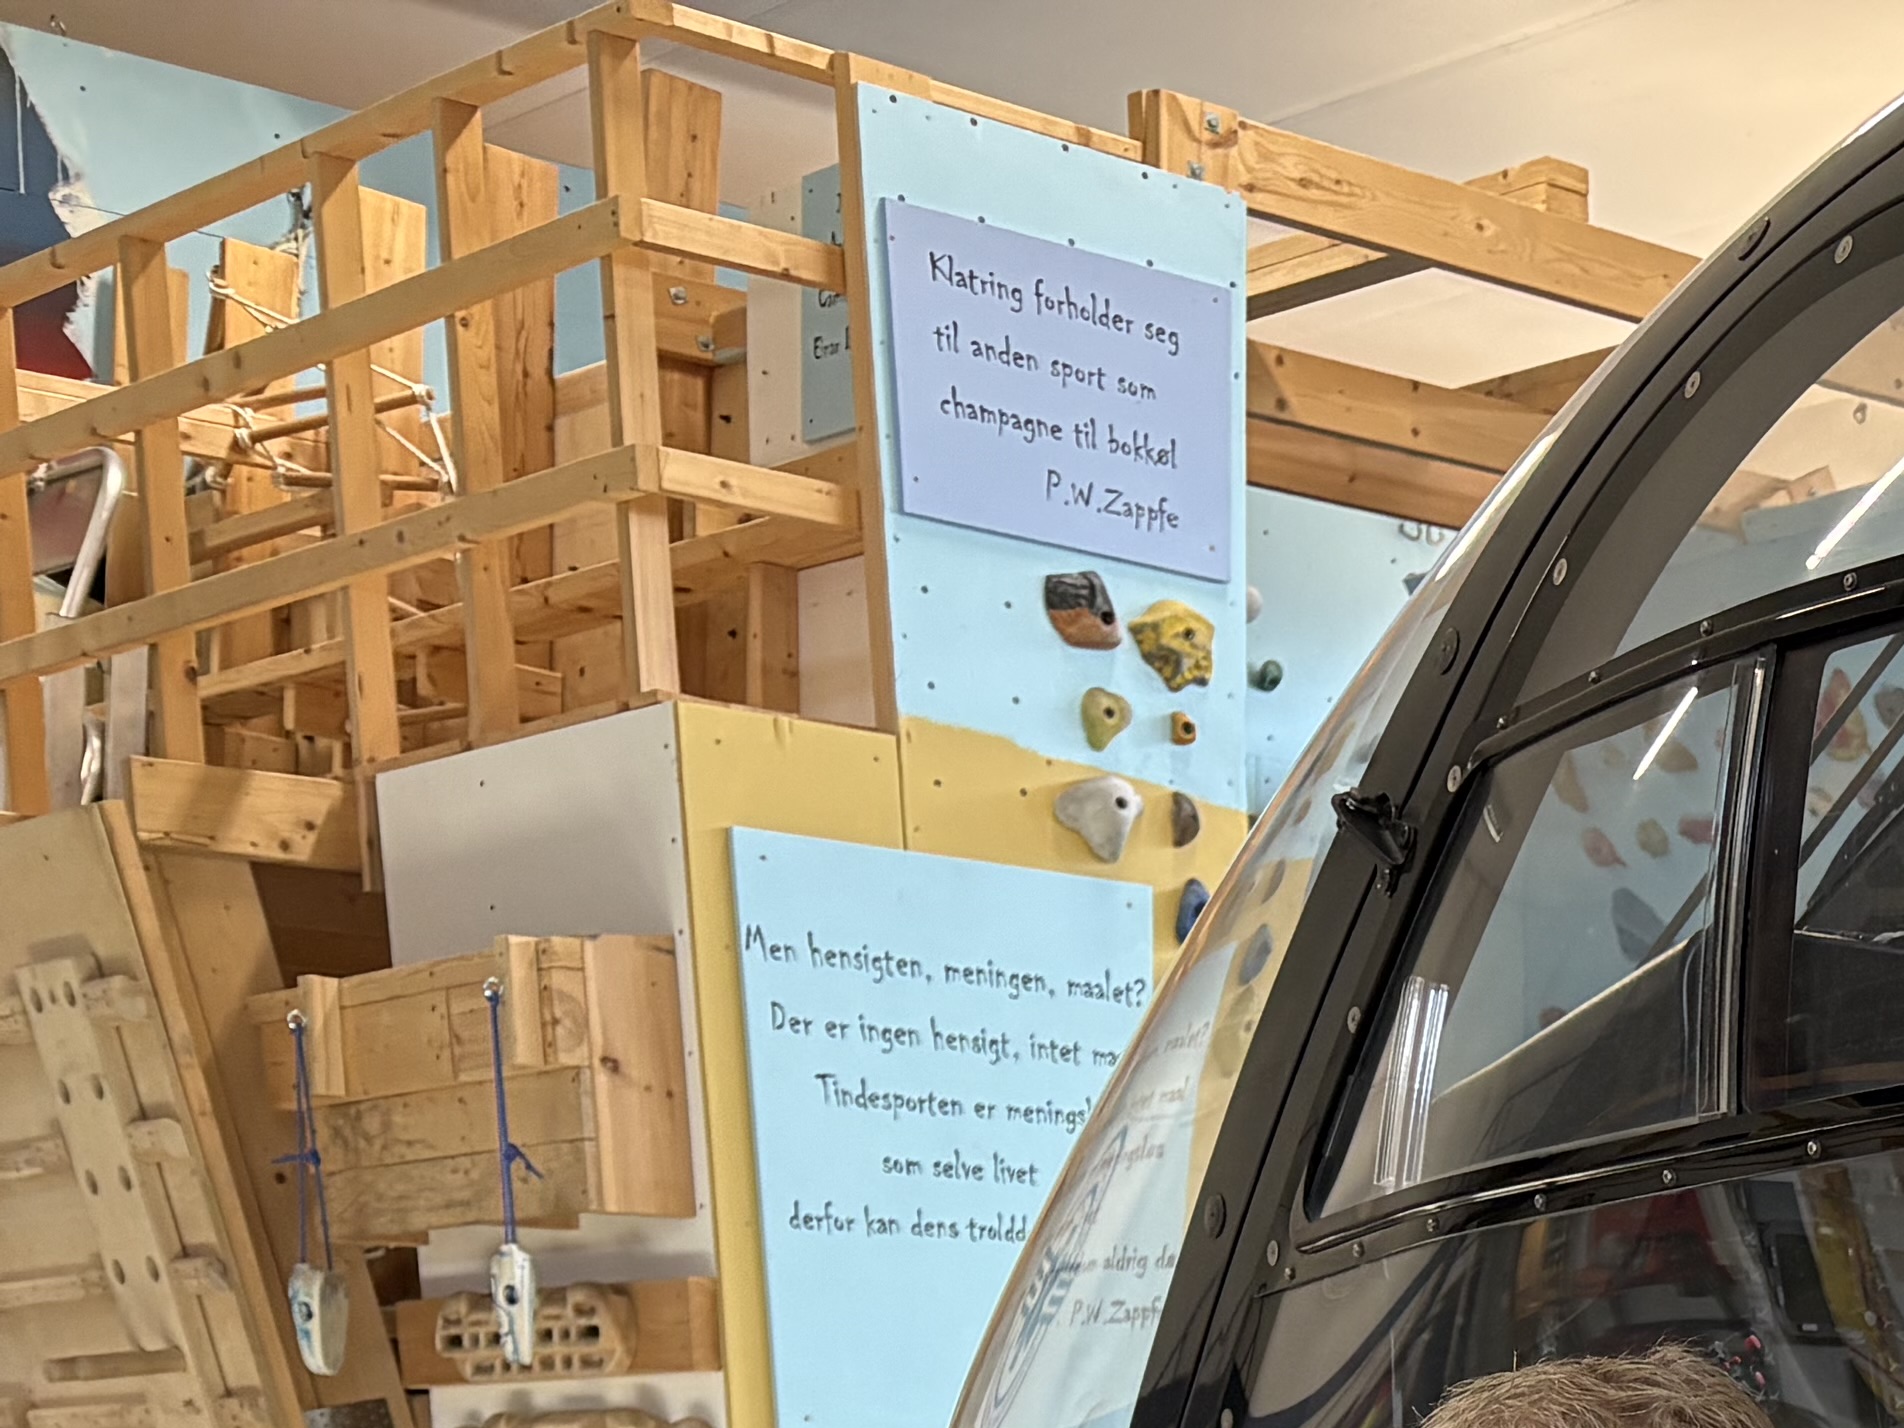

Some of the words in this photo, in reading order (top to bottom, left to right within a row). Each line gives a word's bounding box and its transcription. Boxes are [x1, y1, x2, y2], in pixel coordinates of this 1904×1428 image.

[929, 251, 1023, 313] Klatring
[1034, 278, 1134, 334] forholder
[1144, 322, 1180, 356] seg
[933, 320, 959, 353] til
[970, 335, 1038, 371] anden
[1051, 359, 1106, 391] sport
[1117, 376, 1157, 400] som
[940, 385, 1063, 443] champagne
[1074, 417, 1097, 450] til
[1108, 424, 1177, 469] bokkøl
[745, 923, 797, 962] Men
[807, 930, 932, 984] hensigten,
[944, 959, 1055, 1000] meningen,
[1066, 968, 1147, 1008] maalet?
[770, 1000, 813, 1036] Der
[825, 1019, 849, 1040] er
[858, 1013, 921, 1054] ingen
[930, 1015, 1020, 1066] hensigt,
[1029, 1032, 1082, 1067] intet
[814, 1073, 964, 1120] Tindesporten
[974, 1100, 997, 1119] er
[882, 1155, 922, 1176] som
[933, 1148, 984, 1181] selve
[993, 1151, 1039, 1186] livet
[789, 1199, 855, 1235] derfor
[864, 1204, 900, 1237] kan
[910, 1207, 960, 1238] dens
